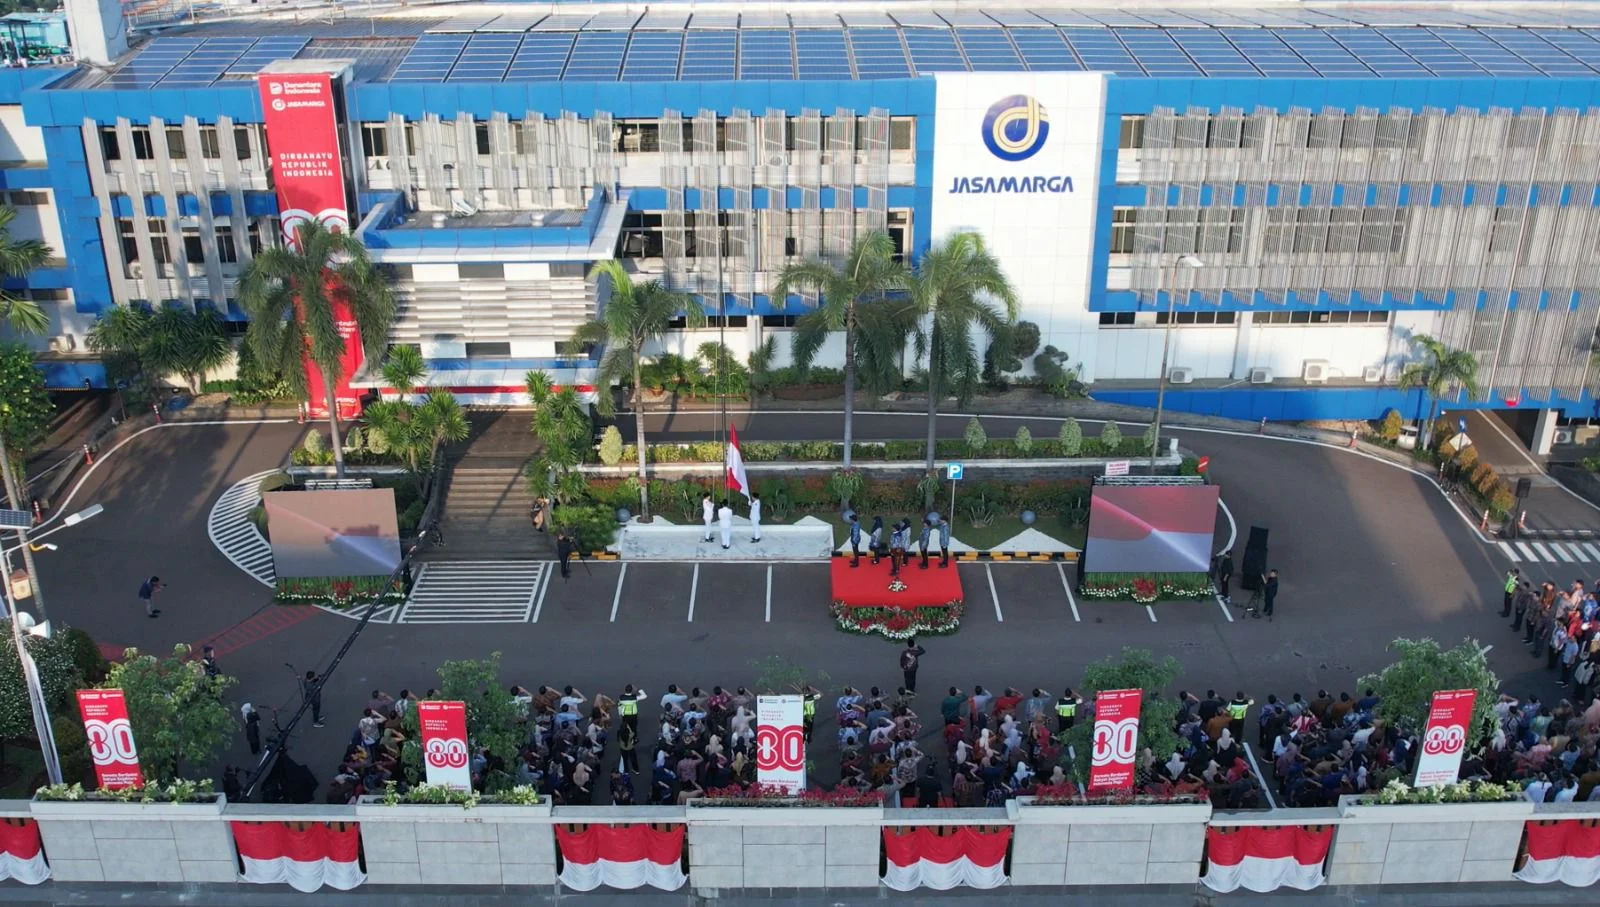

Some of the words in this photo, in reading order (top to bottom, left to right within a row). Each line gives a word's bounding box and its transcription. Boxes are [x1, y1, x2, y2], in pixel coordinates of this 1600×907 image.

[948, 176, 1074, 194] JASAMARGA
[950, 464, 960, 478] P
[84, 718, 138, 766] 80
[426, 738, 468, 768] 80
[757, 725, 804, 771] 80
[1092, 718, 1138, 766] 80
[1424, 724, 1465, 755] 80
